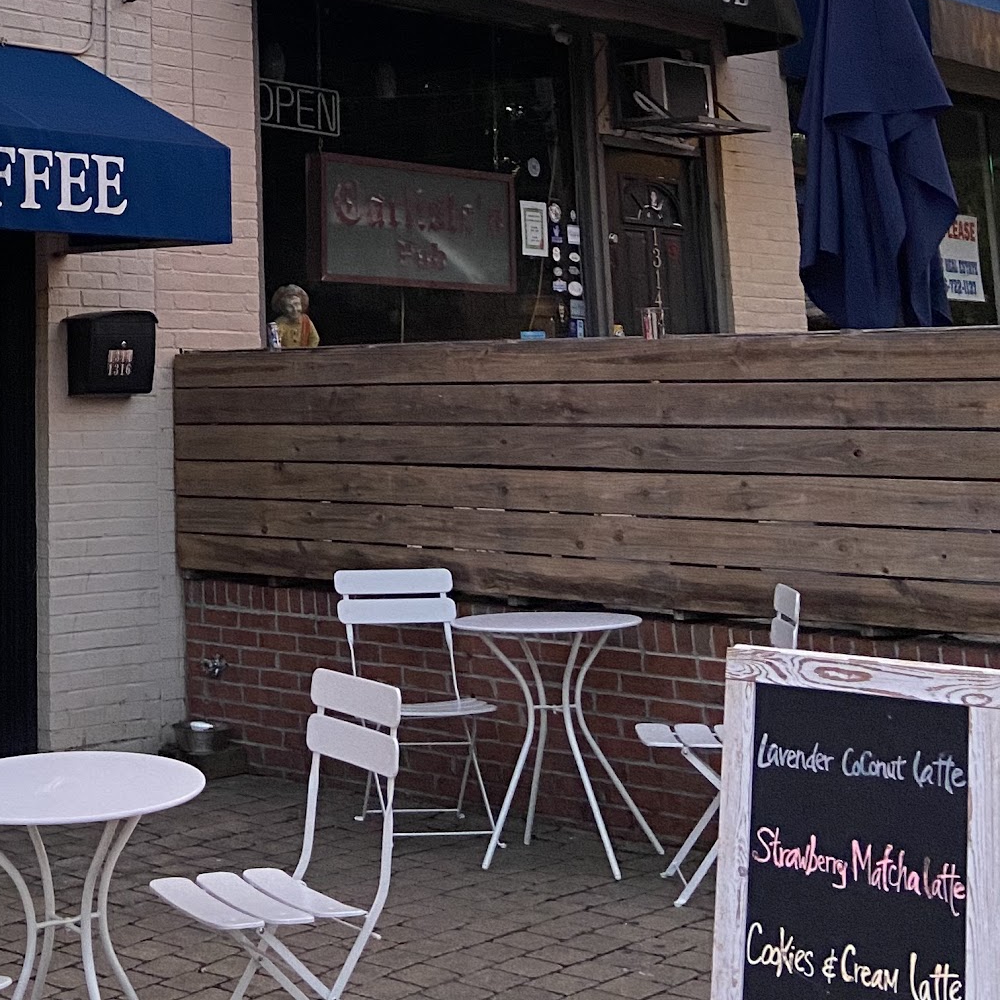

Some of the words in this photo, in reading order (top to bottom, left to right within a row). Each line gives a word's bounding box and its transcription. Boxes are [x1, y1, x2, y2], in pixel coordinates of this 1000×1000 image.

[260, 83, 336, 131] OPEN
[107, 363, 132, 376] 1316
[757, 733, 835, 773] Lavender
[751, 827, 848, 889] Strawberry
[851, 839, 922, 896] Matcha
[821, 948, 838, 984] &
